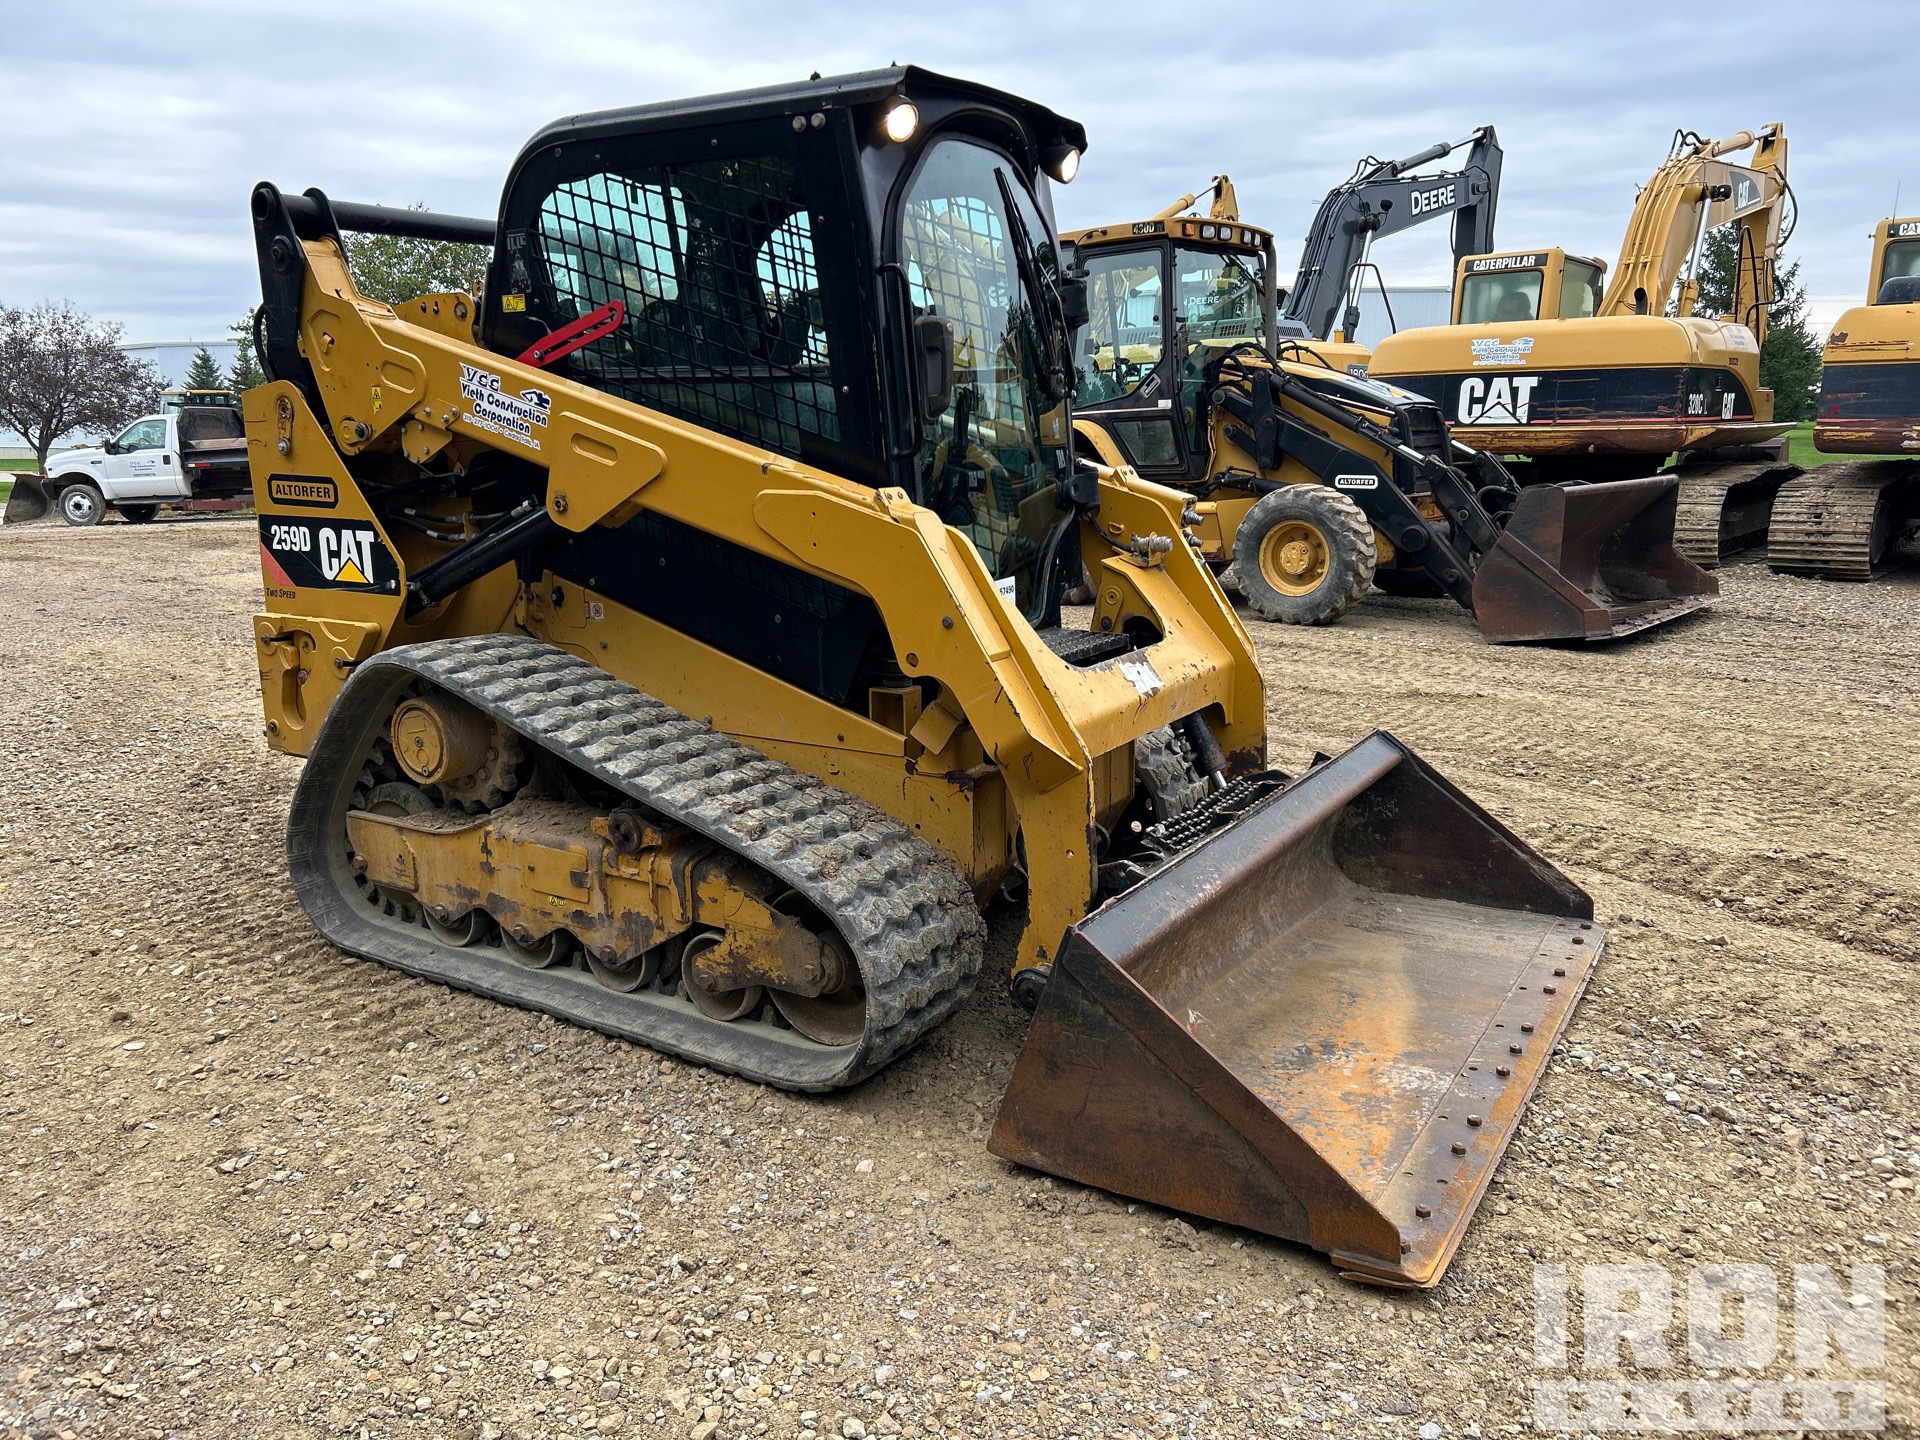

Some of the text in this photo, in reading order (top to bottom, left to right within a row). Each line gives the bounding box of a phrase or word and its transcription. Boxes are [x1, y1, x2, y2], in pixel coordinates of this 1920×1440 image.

[1411, 185, 1455, 216] DEERE
[1473, 255, 1536, 271] CATERPILLAR
[1189, 296, 1219, 305] DEERE
[464, 365, 499, 392] VCC
[461, 382, 547, 427] Vieth Construction
[1457, 376, 1539, 425] CAT
[1688, 393, 1704, 414] 320C
[1721, 392, 1735, 420] CAT
[474, 403, 531, 434] Corporation
[275, 483, 331, 499] ALTORFER
[270, 524, 375, 584] 259D CAT
[1059, 1031, 1107, 1070] CAT
